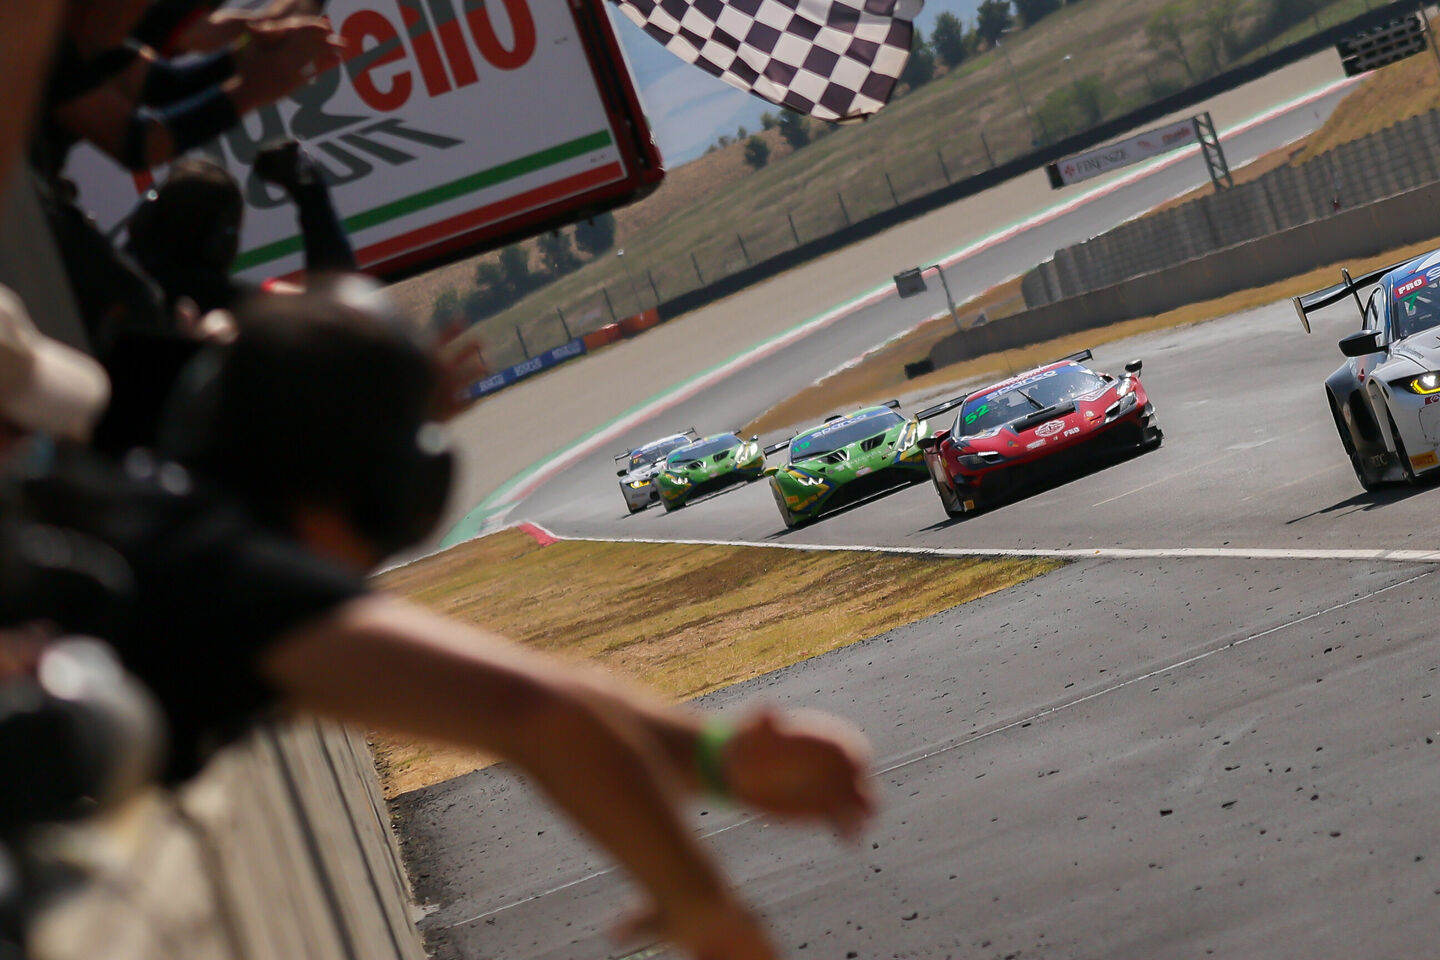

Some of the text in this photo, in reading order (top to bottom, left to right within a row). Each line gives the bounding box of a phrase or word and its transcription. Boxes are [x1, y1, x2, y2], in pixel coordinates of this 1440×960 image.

[1398, 277, 1423, 295] PRO
[1402, 292, 1420, 311] 7
[985, 370, 1058, 401] sparco
[964, 404, 990, 425] 52
